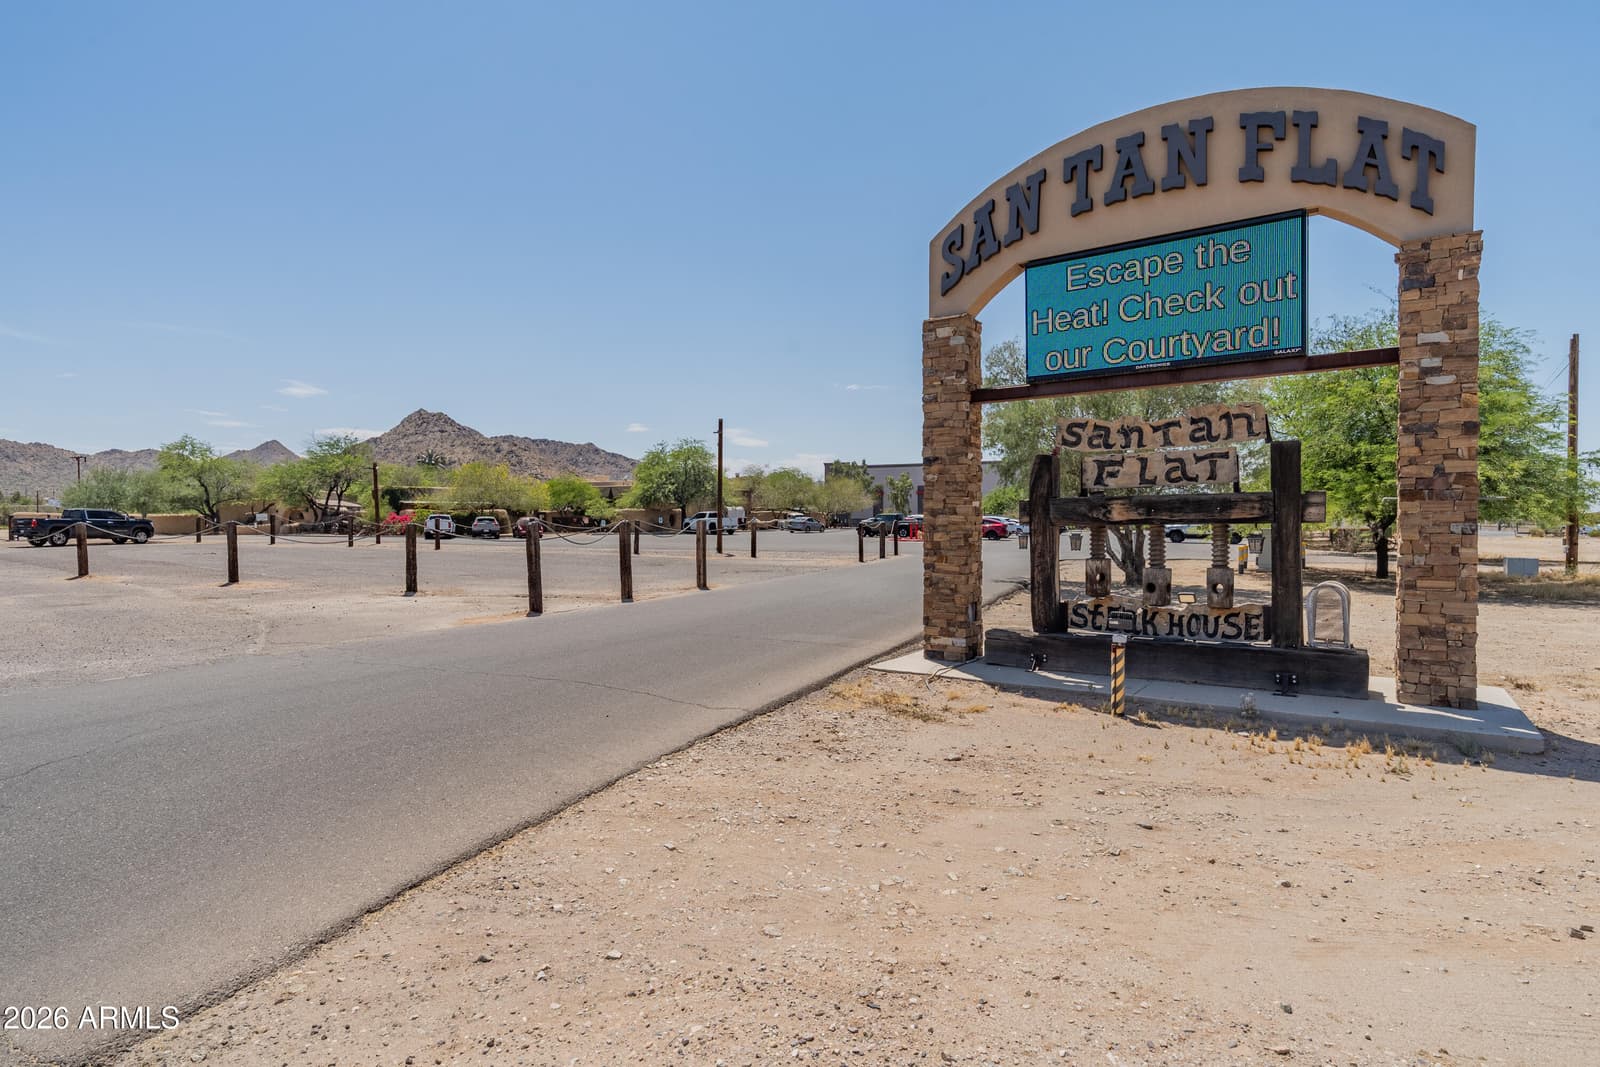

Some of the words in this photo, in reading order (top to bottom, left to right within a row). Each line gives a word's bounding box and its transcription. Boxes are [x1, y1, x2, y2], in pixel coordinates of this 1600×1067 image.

[941, 168, 1047, 296] SAN
[1063, 116, 1214, 217] TAN
[1238, 110, 1446, 216] FLAT
[1066, 250, 1184, 292] Escape
[1194, 238, 1251, 270] the
[1031, 299, 1109, 336] Heat!
[1118, 281, 1226, 322] Check
[1238, 271, 1298, 306] out
[1044, 345, 1092, 372] our
[1103, 316, 1281, 365] Courtyard!
[1168, 611, 1262, 640] HOUSE
